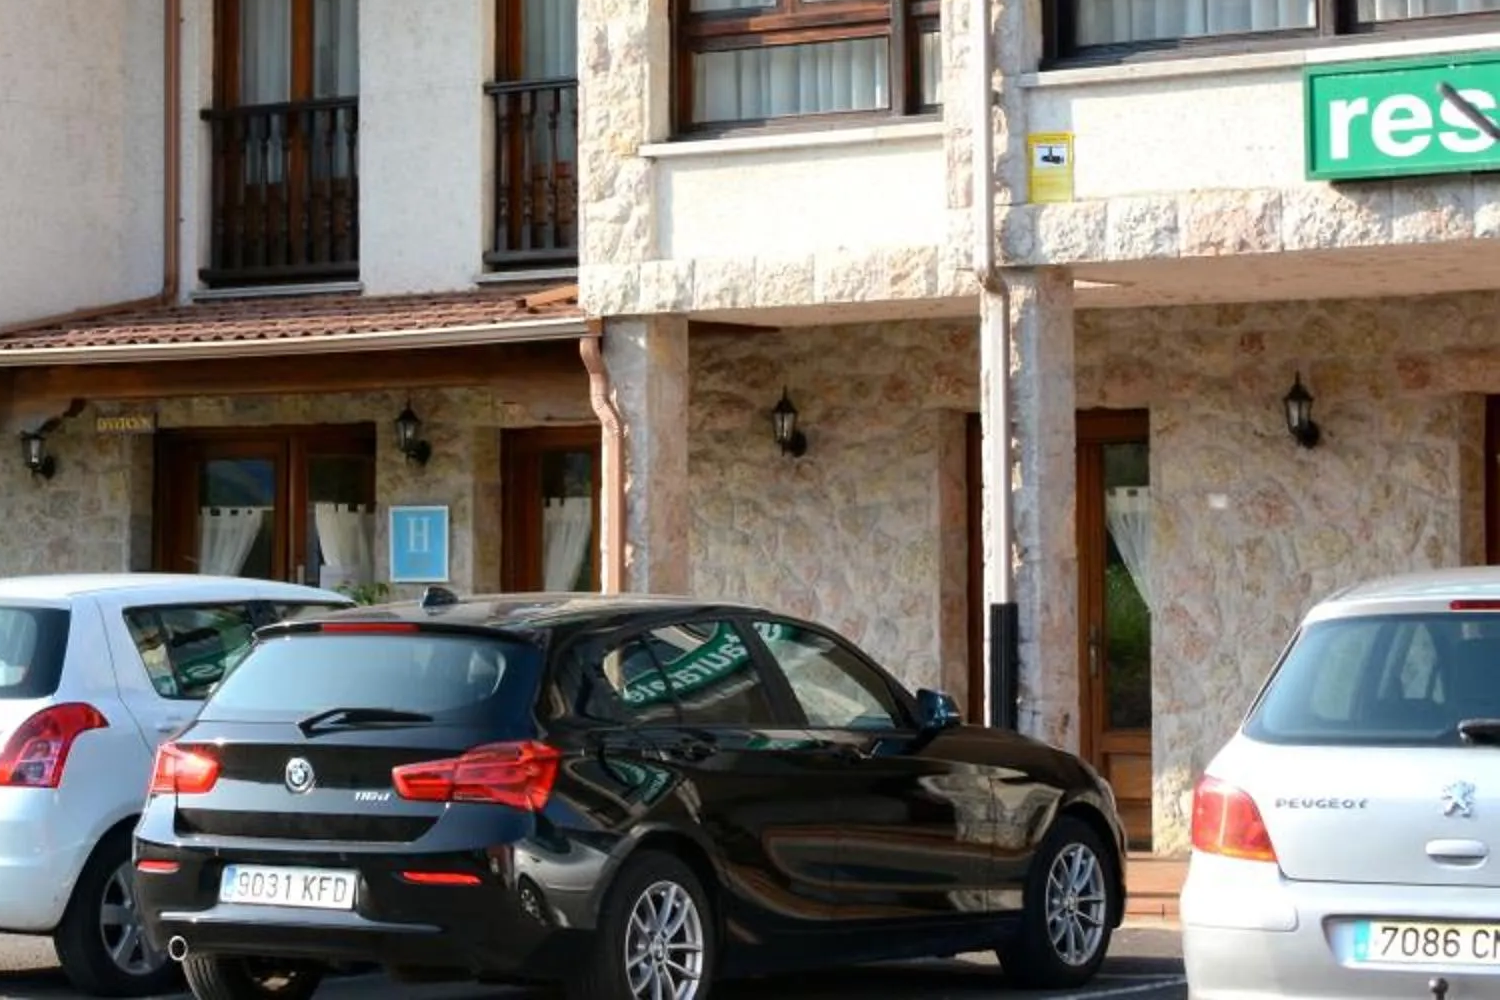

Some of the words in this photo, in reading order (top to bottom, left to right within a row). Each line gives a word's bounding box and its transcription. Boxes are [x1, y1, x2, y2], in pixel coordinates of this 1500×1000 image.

[407, 516, 431, 552] H
[1275, 798, 1369, 809] PEUGEOT
[237, 871, 292, 900] 9031
[301, 874, 347, 903] KFD
[1381, 926, 1461, 958] 7086
